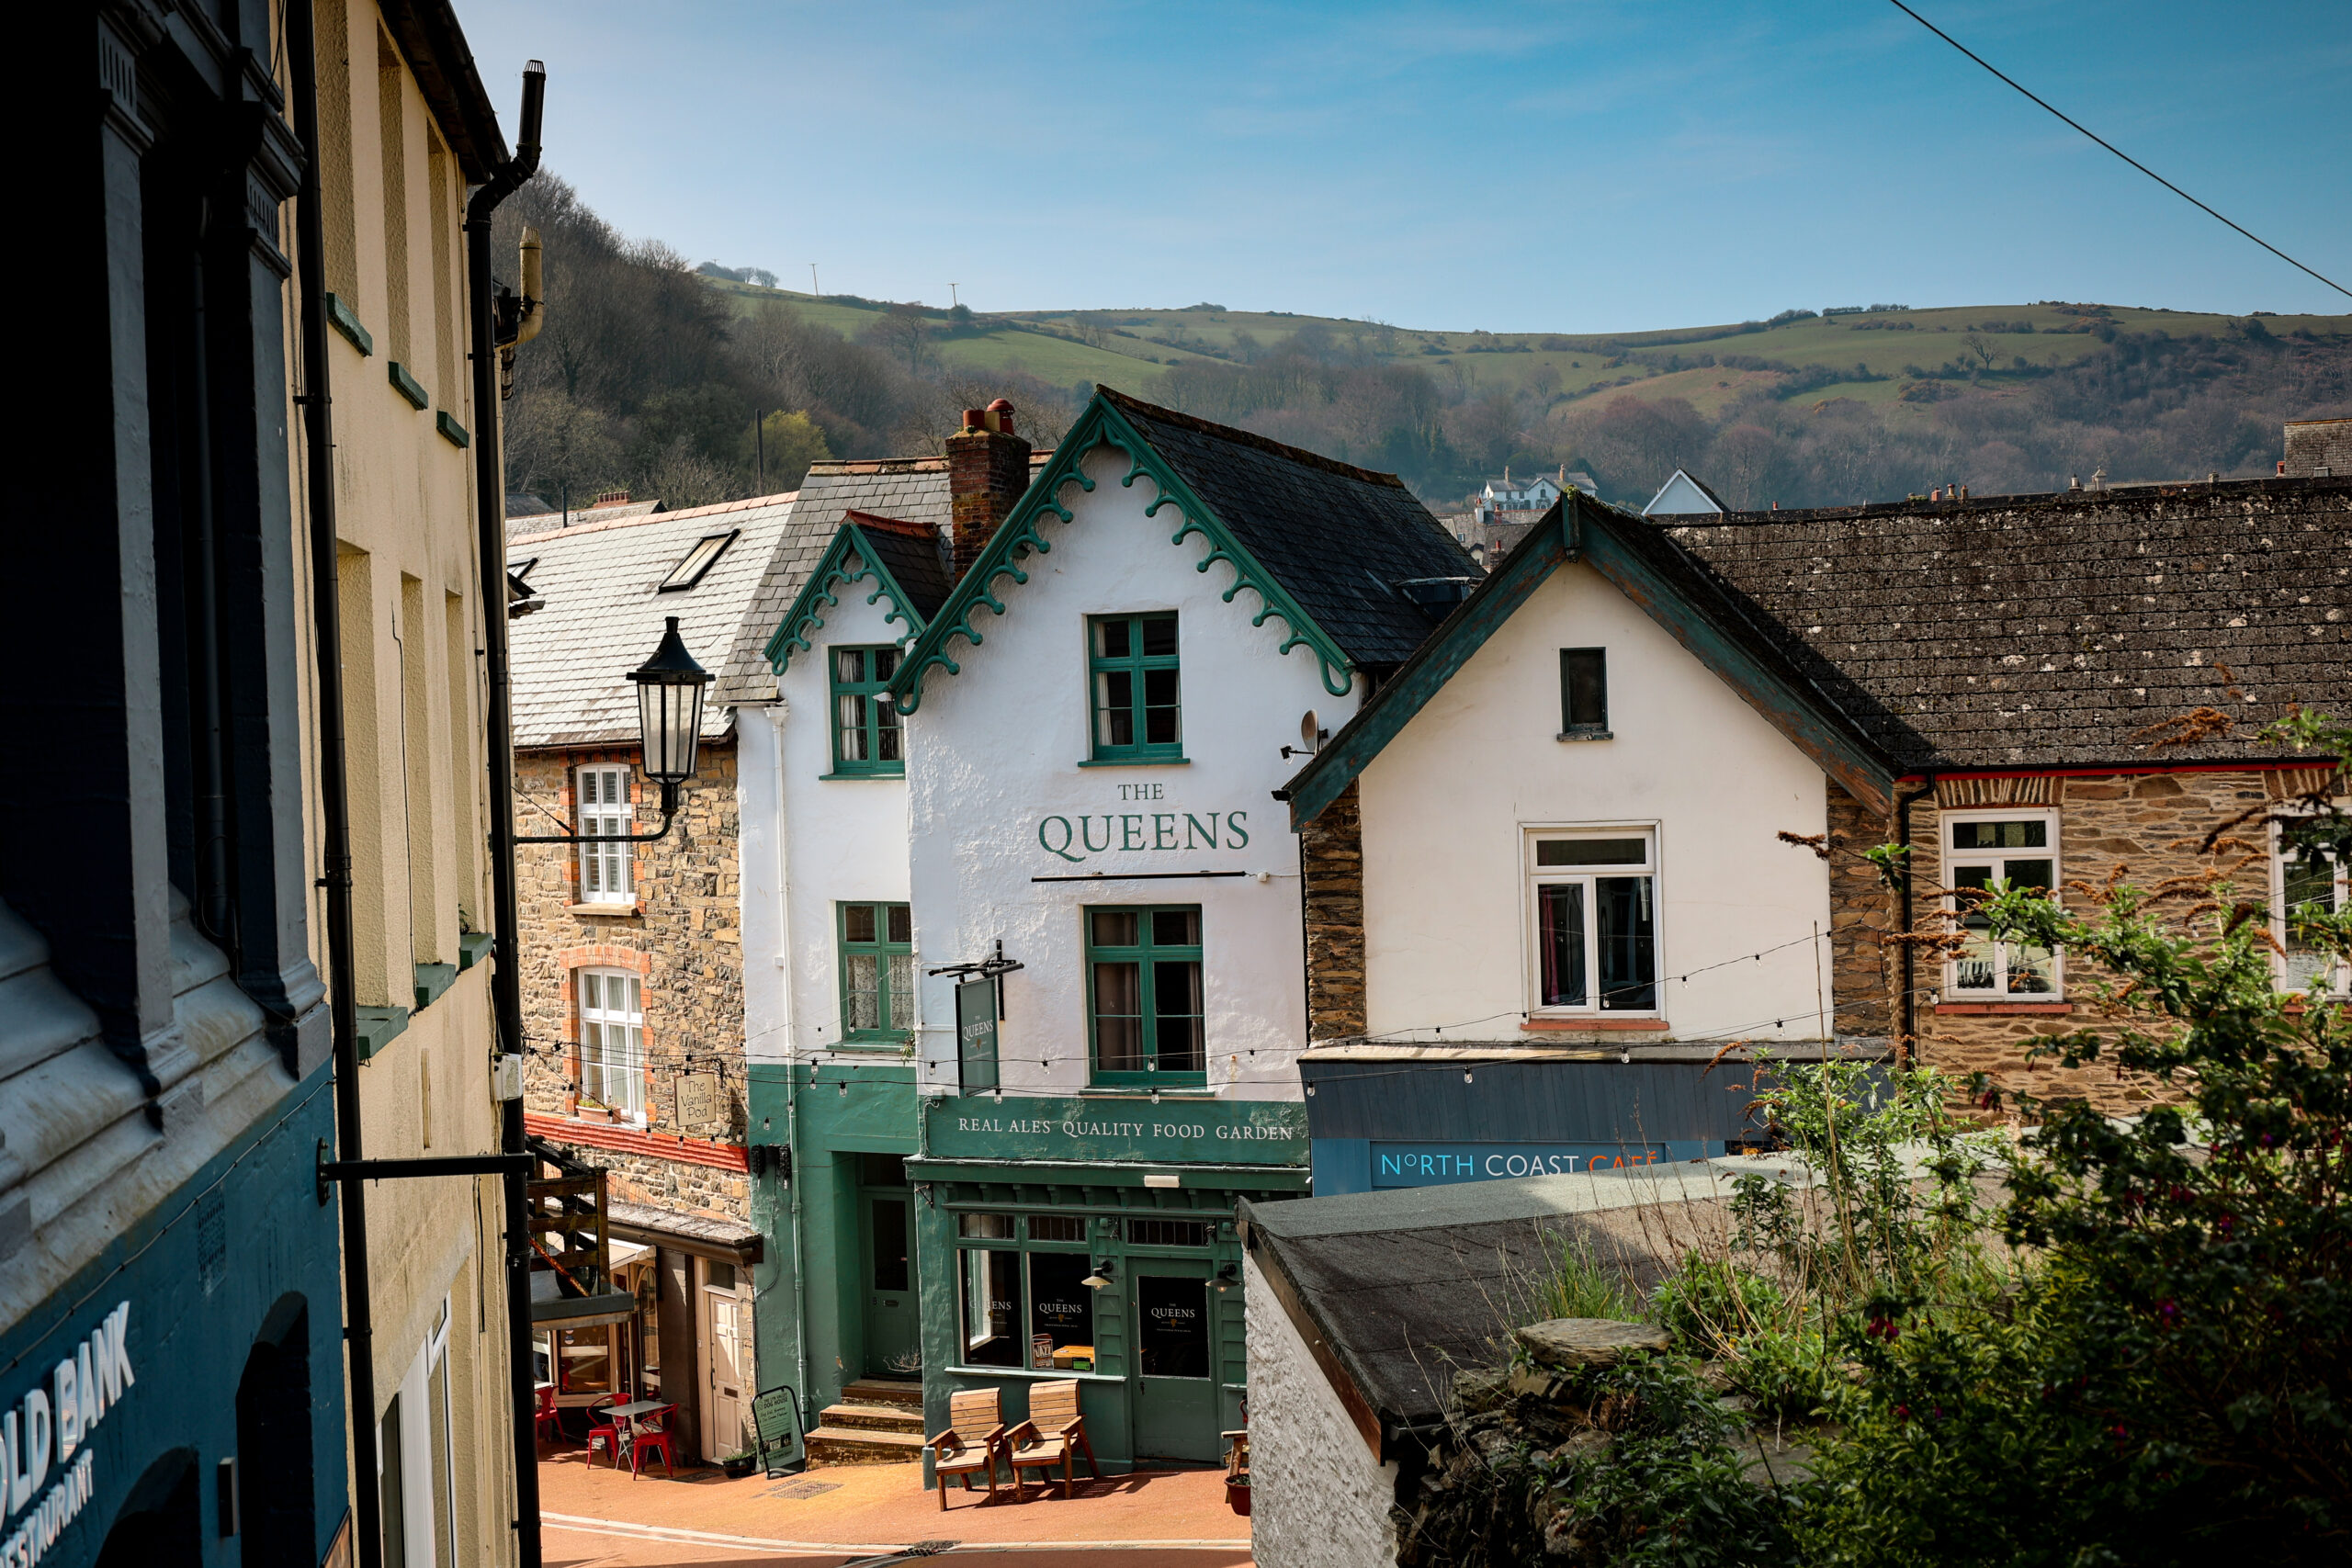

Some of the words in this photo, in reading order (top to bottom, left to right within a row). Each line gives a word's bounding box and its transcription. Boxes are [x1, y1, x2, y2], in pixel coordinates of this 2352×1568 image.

[1117, 784, 1164, 801] THE
[1038, 810, 1250, 863] QUEENS
[963, 1020, 994, 1042] QUEENS
[688, 1080, 707, 1093] The
[681, 1092, 712, 1107] Vanilla
[686, 1104, 707, 1120] Pod
[958, 1118, 1003, 1133] REAL
[1008, 1119, 1051, 1134] ALES
[1062, 1121, 1144, 1138] QUALITY
[1153, 1123, 1205, 1138] FOOD
[1216, 1125, 1294, 1141] GARDEN
[1381, 1154, 1474, 1176] NORTH
[1485, 1155, 1579, 1177] COAST
[1039, 1303, 1082, 1314] QUEENS
[1151, 1307, 1195, 1319] QUEENS
[1035, 1344, 1052, 1358] JAZZ
[0, 1388, 51, 1531] LD
[54, 1300, 135, 1464] BANK
[0, 1449, 94, 1568] ESTAURANT
